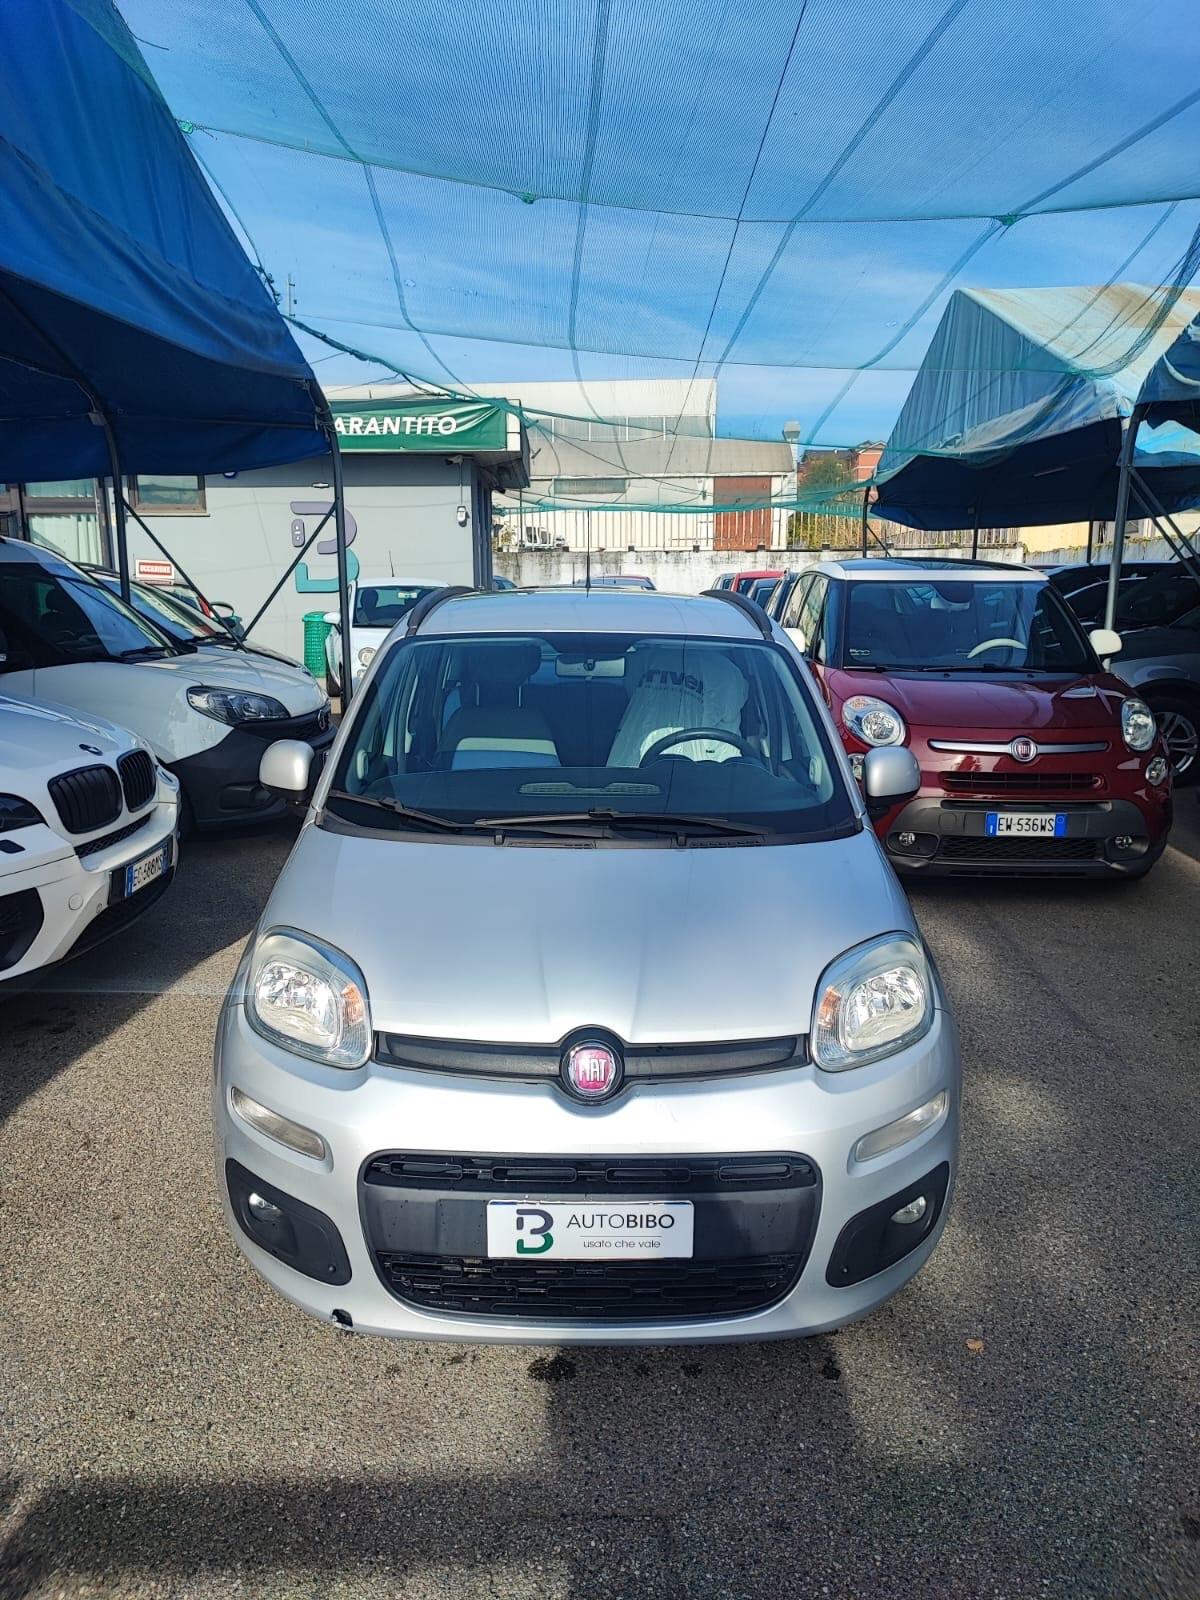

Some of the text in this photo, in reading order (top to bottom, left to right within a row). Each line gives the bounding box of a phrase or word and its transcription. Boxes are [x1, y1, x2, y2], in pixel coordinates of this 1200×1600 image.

[334, 416, 457, 436] ARANTITO
[998, 817, 1054, 832] EW 536WS
[579, 1056, 608, 1082] FIAT
[566, 1213, 675, 1229] AUTOBIBO
[583, 1239, 661, 1249] usato che vale
